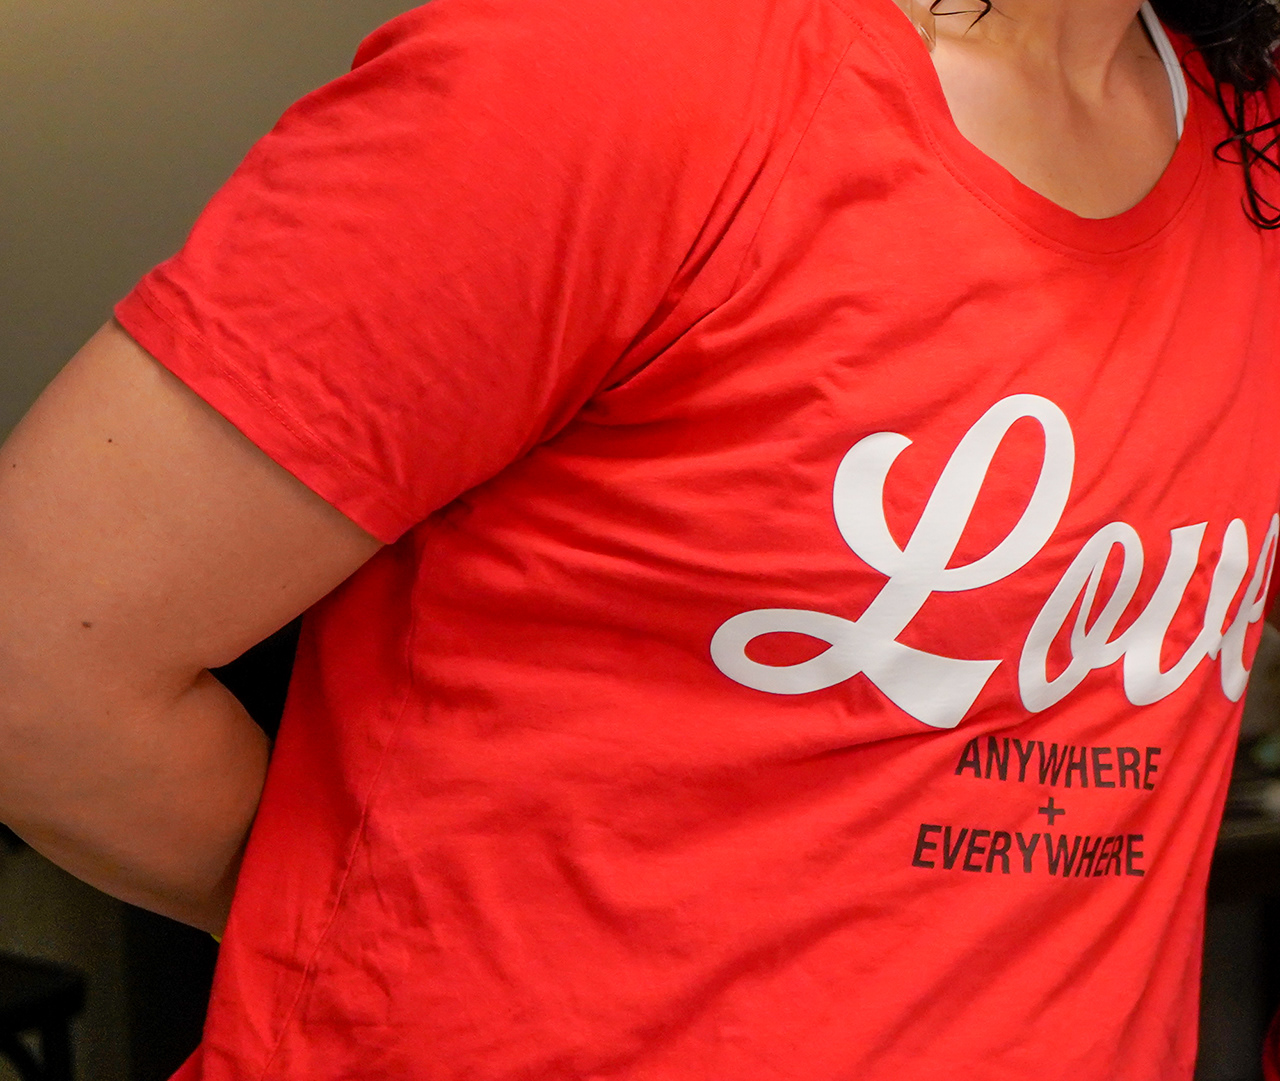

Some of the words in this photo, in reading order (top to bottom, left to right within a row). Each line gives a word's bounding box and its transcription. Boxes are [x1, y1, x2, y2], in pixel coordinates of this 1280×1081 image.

[710, 393, 1280, 728] Love
[954, 736, 1162, 791] ANYWHERE
[911, 823, 1145, 878] EVERYWHERE
